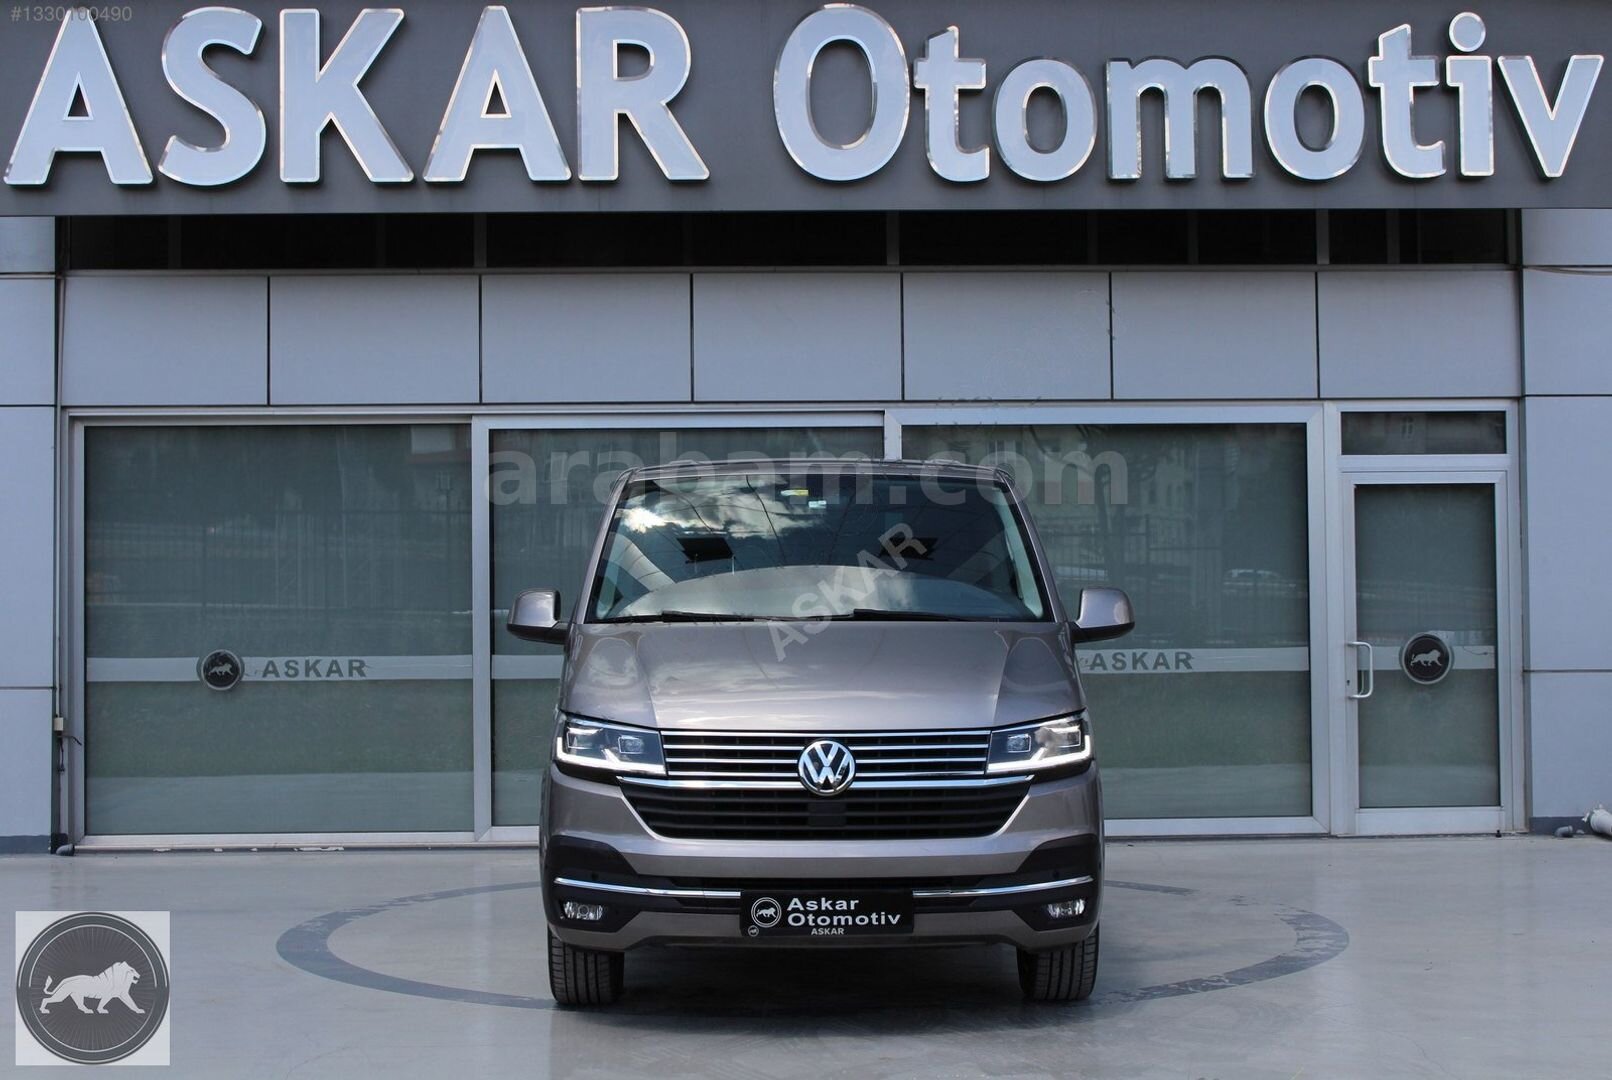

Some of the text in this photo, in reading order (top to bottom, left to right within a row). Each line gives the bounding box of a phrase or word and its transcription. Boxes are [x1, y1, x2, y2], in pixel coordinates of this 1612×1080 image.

[4, 3, 1605, 187] ASKAR Otomotiv
[262, 658, 367, 679] ASKAR
[1089, 650, 1194, 672] ASKAR
[787, 897, 860, 911] Askar
[787, 911, 901, 927] Otomotiv
